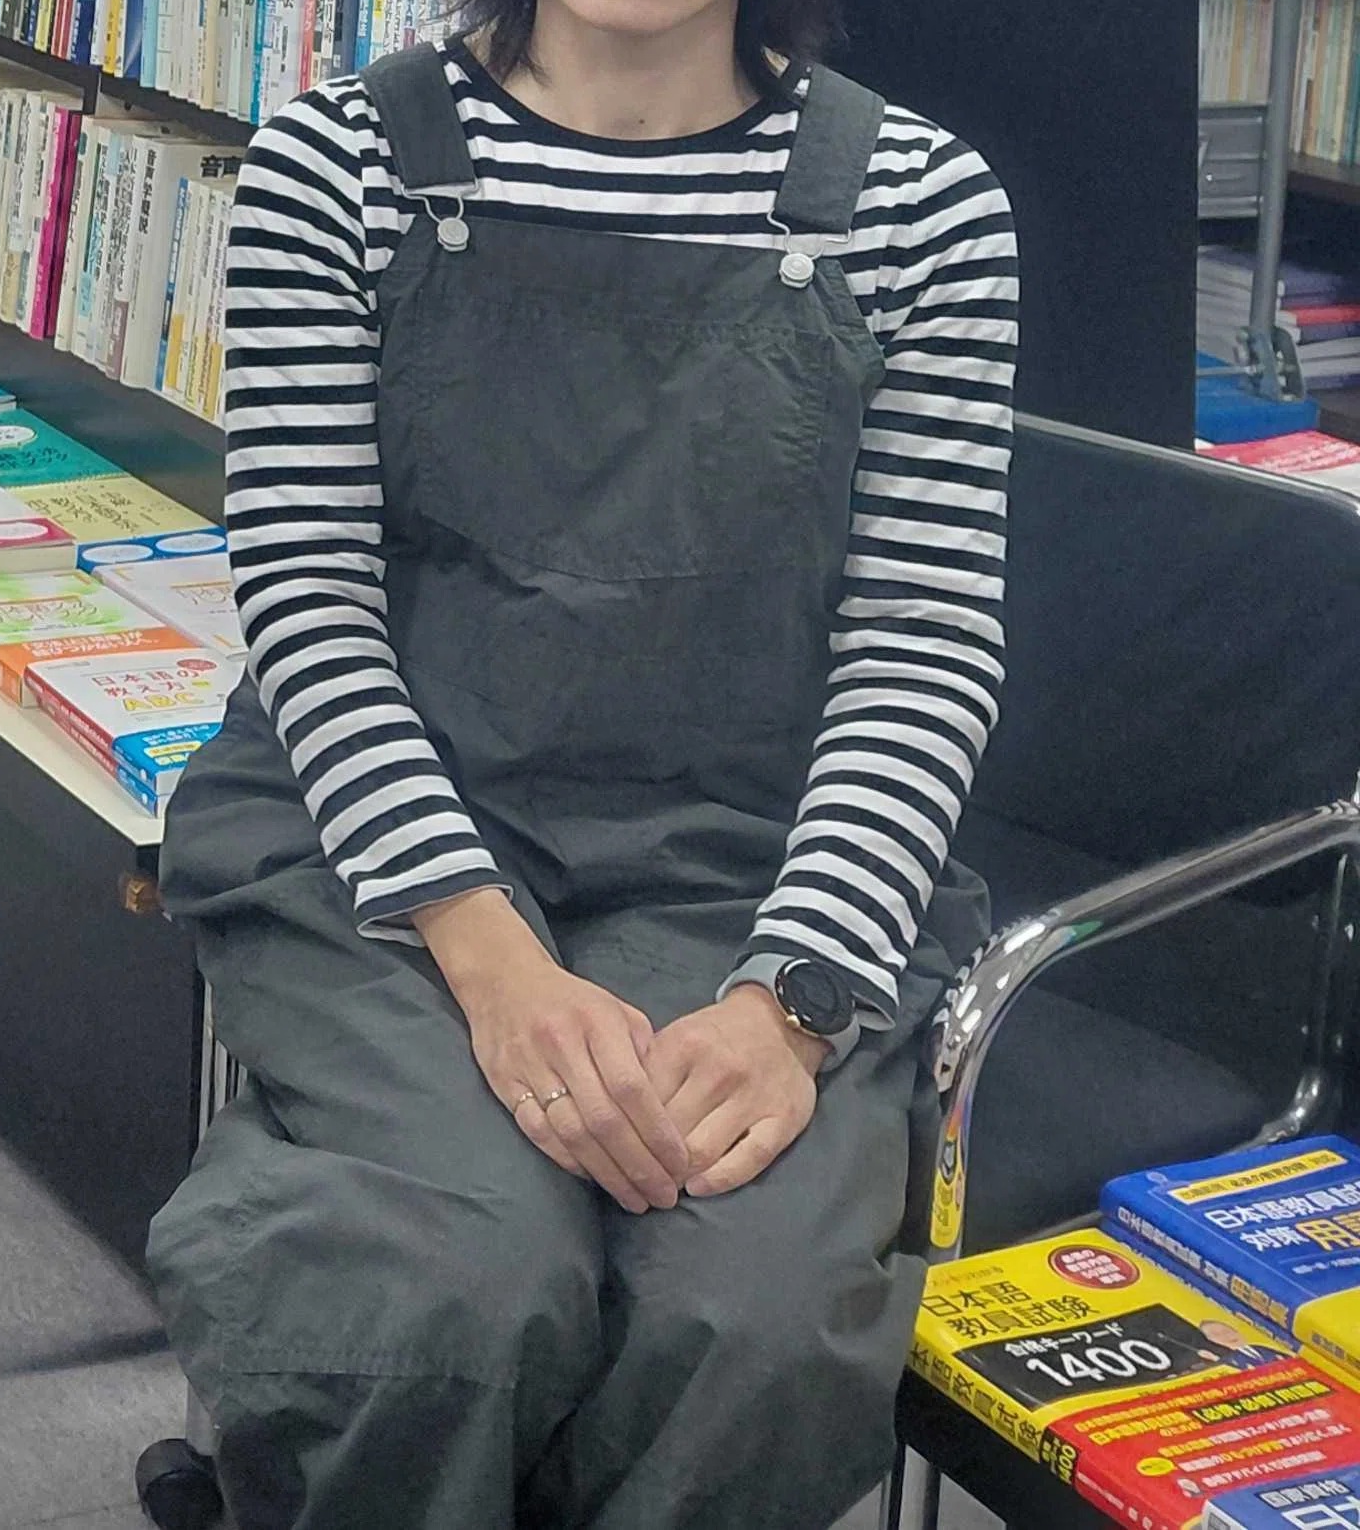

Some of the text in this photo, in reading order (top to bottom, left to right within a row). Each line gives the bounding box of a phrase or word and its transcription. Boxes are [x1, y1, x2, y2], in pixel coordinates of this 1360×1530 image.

[91, 668, 200, 690] 日本語の
[103, 681, 185, 699] 教え方
[123, 692, 204, 713] ABC
[1204, 1179, 1360, 1229] 日本語教員試
[923, 1280, 1031, 1318] 日本語
[947, 1294, 1101, 1339] 教員試験
[1003, 1321, 1125, 1357] 合格キーワード
[1026, 1339, 1171, 1388] 1400
